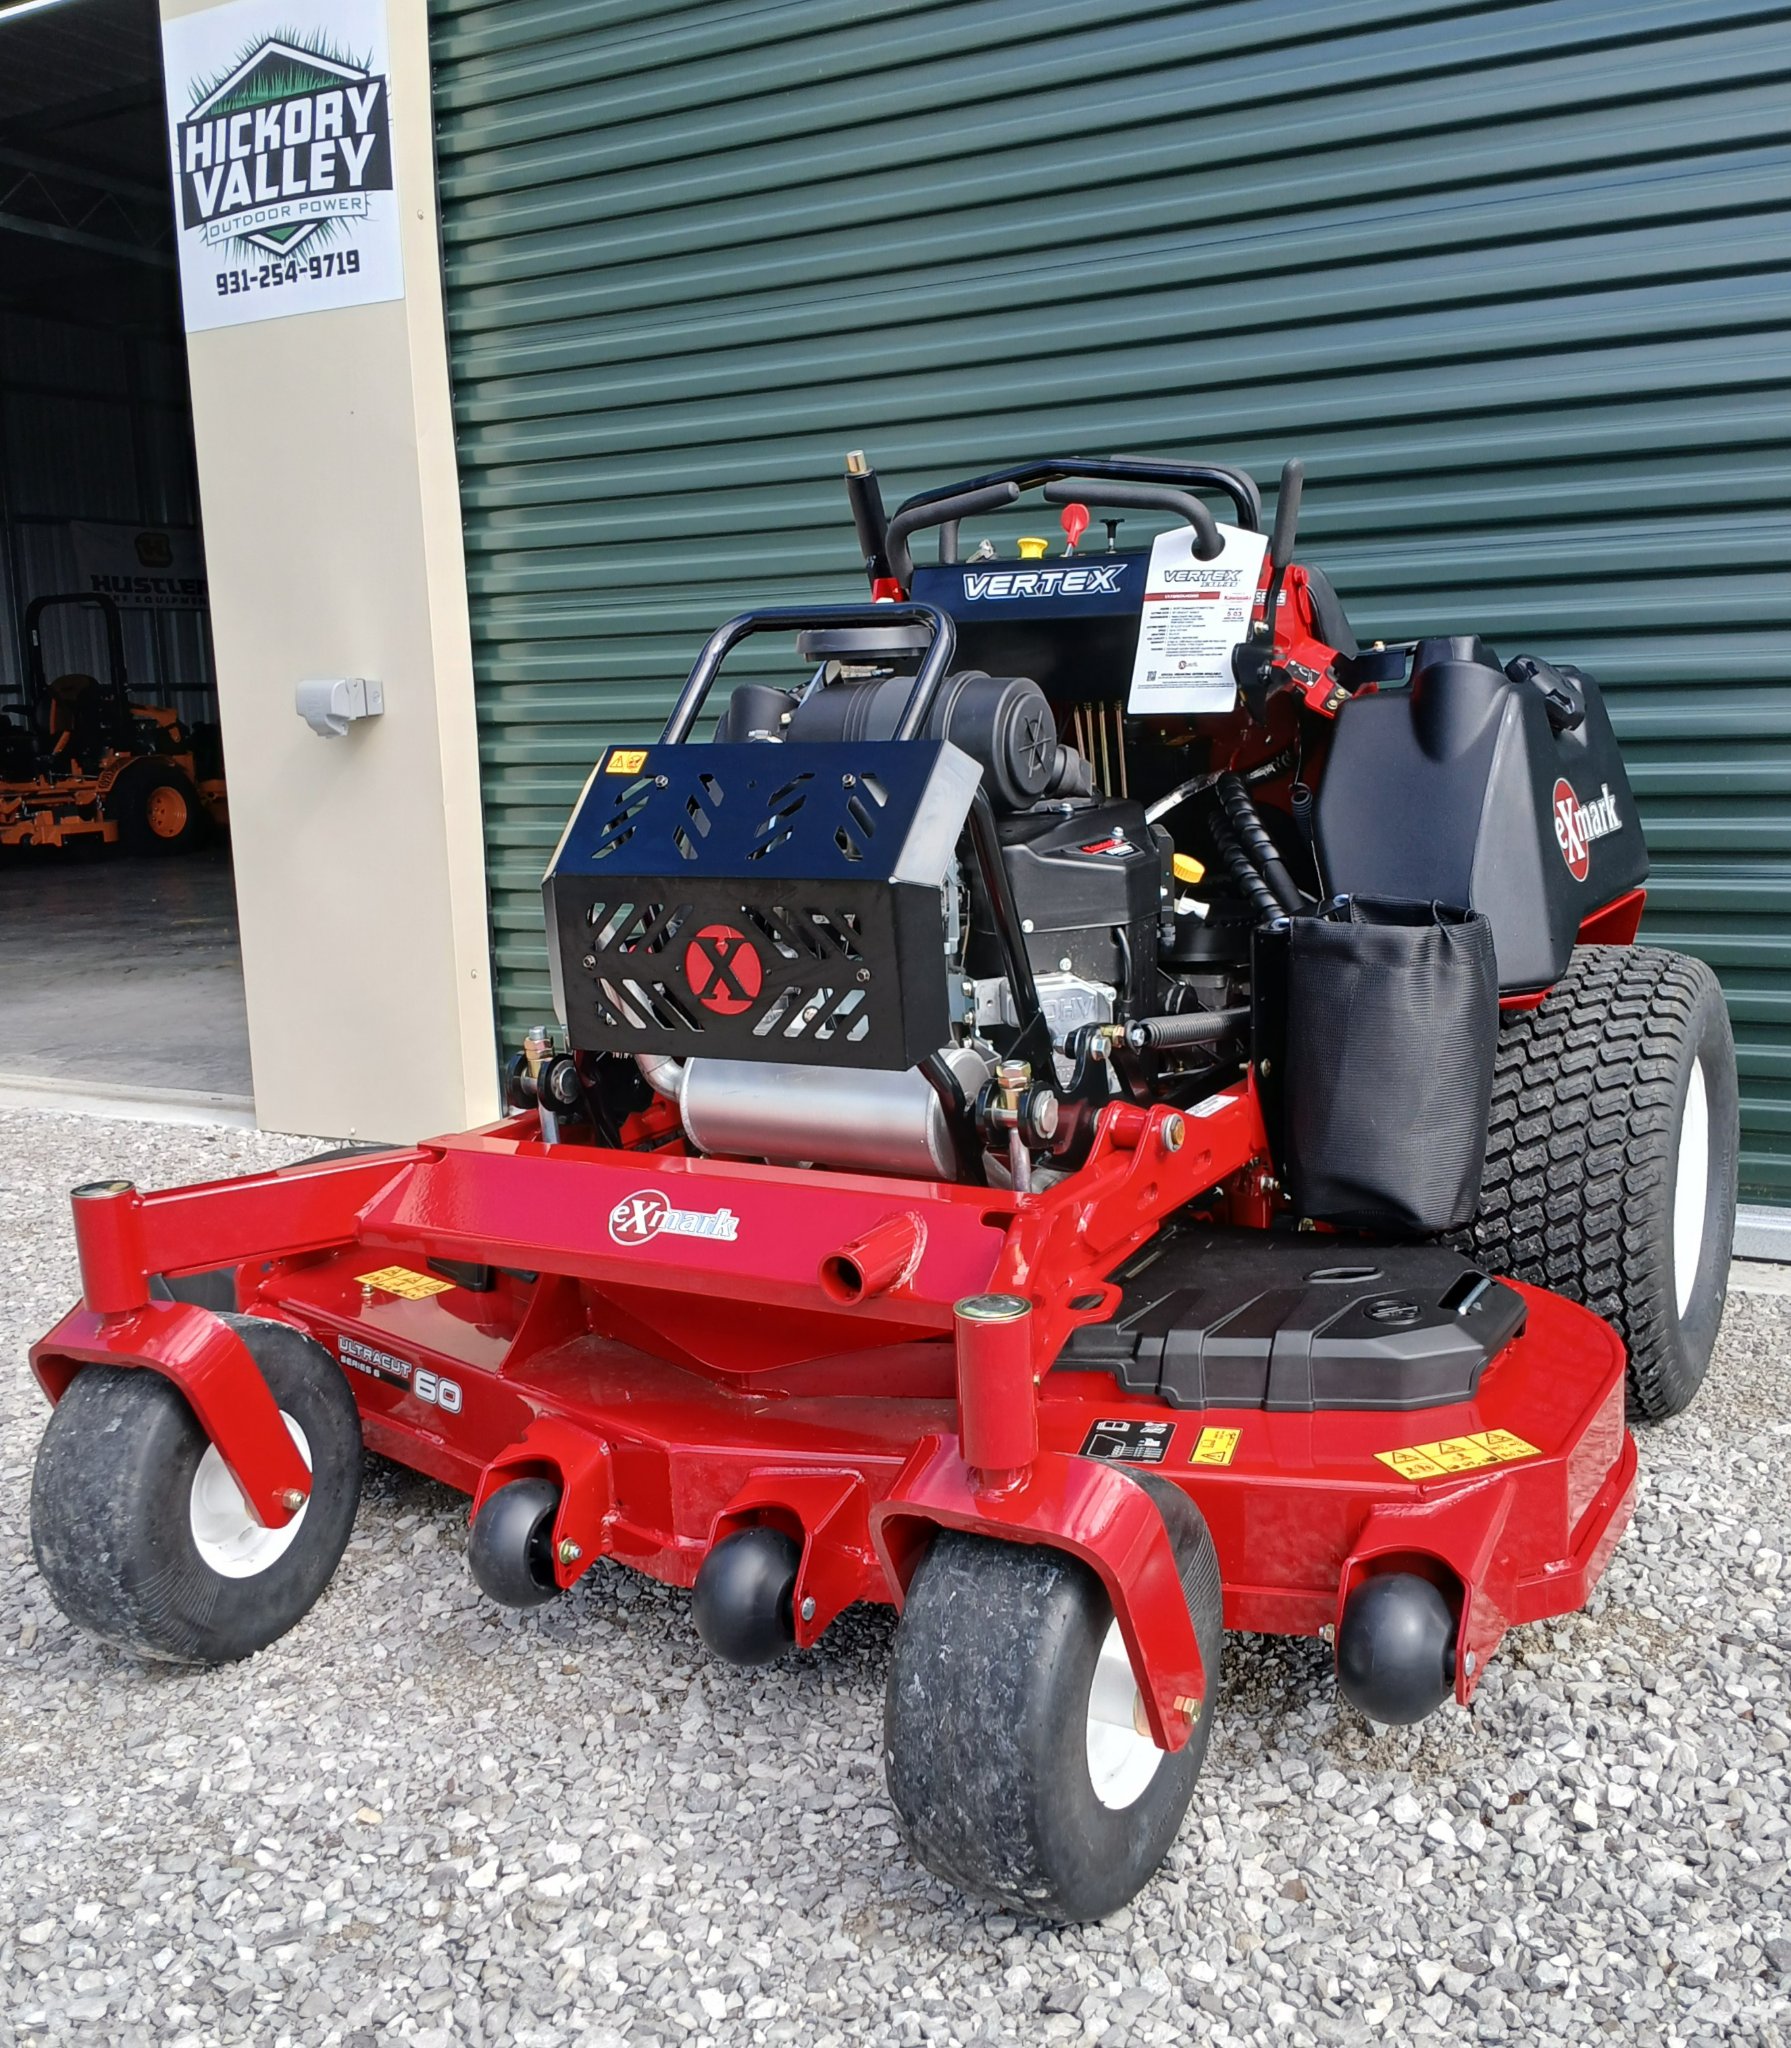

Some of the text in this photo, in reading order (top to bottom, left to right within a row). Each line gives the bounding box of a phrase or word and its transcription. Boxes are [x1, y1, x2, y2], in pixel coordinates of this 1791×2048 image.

[184, 82, 381, 173] HICKORY
[192, 133, 376, 219] VALLEY
[210, 197, 362, 239] OUTDOOR POWER
[216, 249, 361, 296] 931-254-9719
[964, 564, 1127, 600] VERTEX
[1164, 569, 1243, 582] VERTEX
[135, 595, 207, 605] EQUIPMEN
[338, 1334, 412, 1379] ULTRACUT
[340, 1355, 372, 1374] SERIES
[414, 1368, 462, 1414] 60
